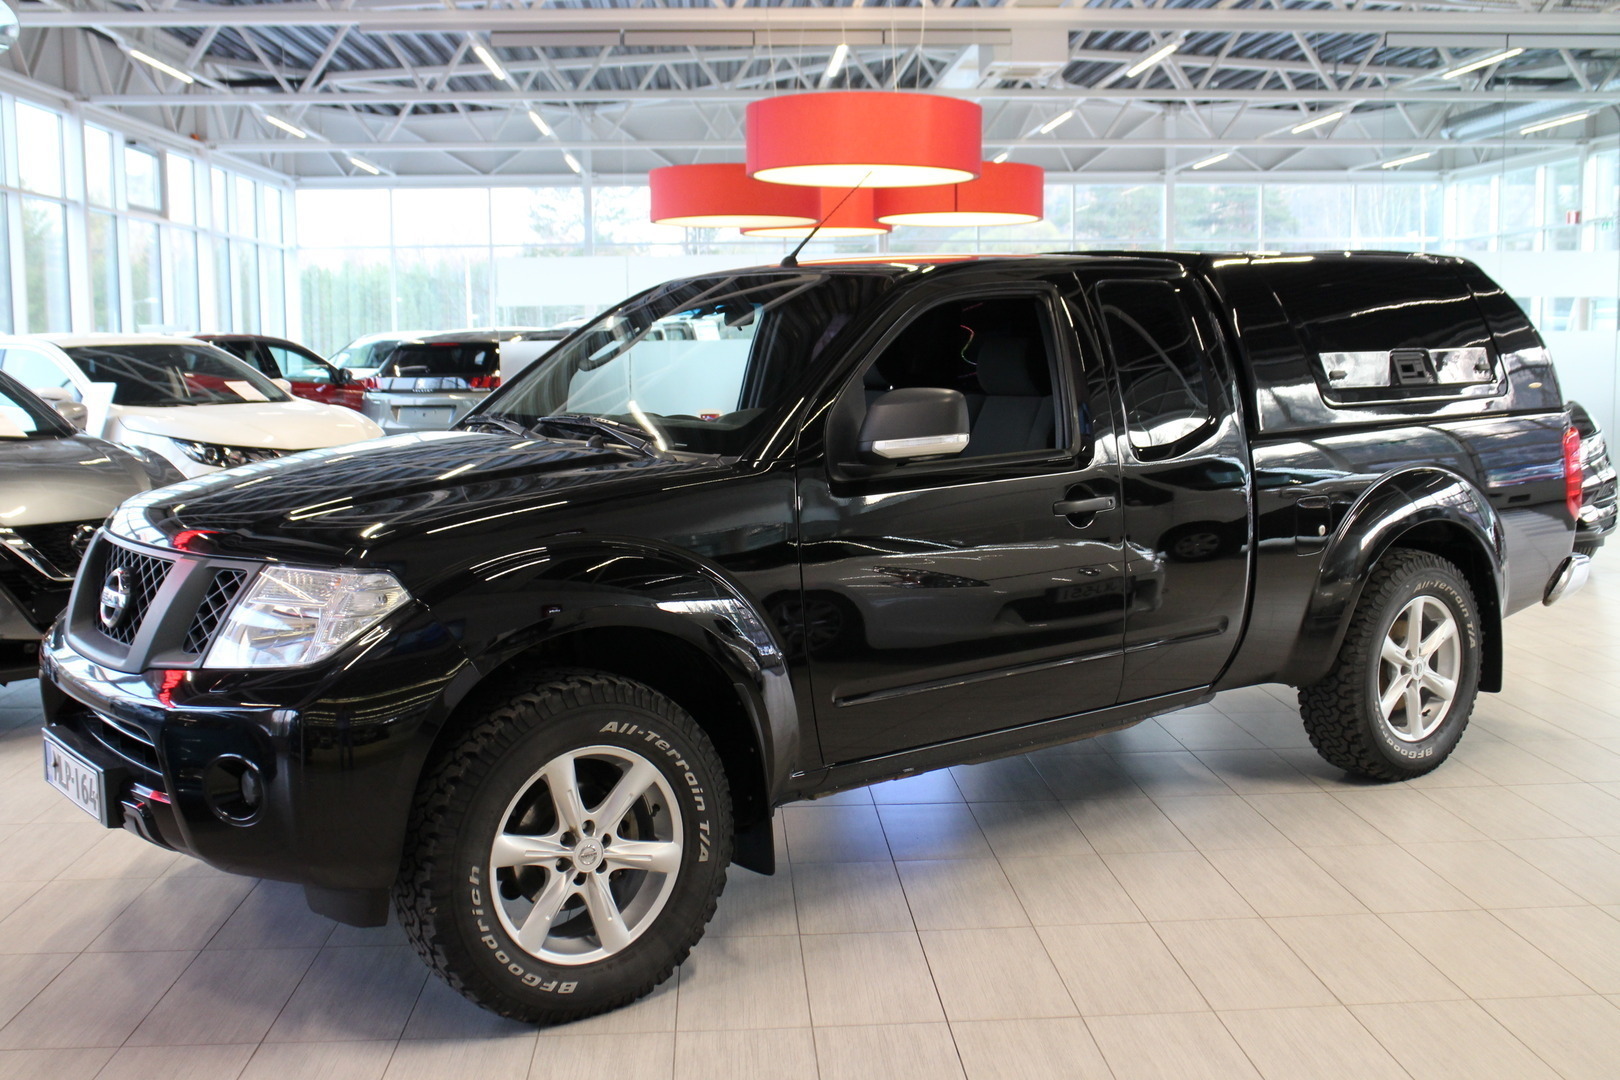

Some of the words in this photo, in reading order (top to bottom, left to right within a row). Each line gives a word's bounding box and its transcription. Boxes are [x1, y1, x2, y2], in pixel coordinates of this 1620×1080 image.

[1413, 580, 1469, 618] All-Terrain
[1466, 620, 1476, 649] T/A
[600, 721, 706, 811] All-Terrain
[698, 820, 711, 864] T/A
[468, 865, 579, 994] BFGoodrich
